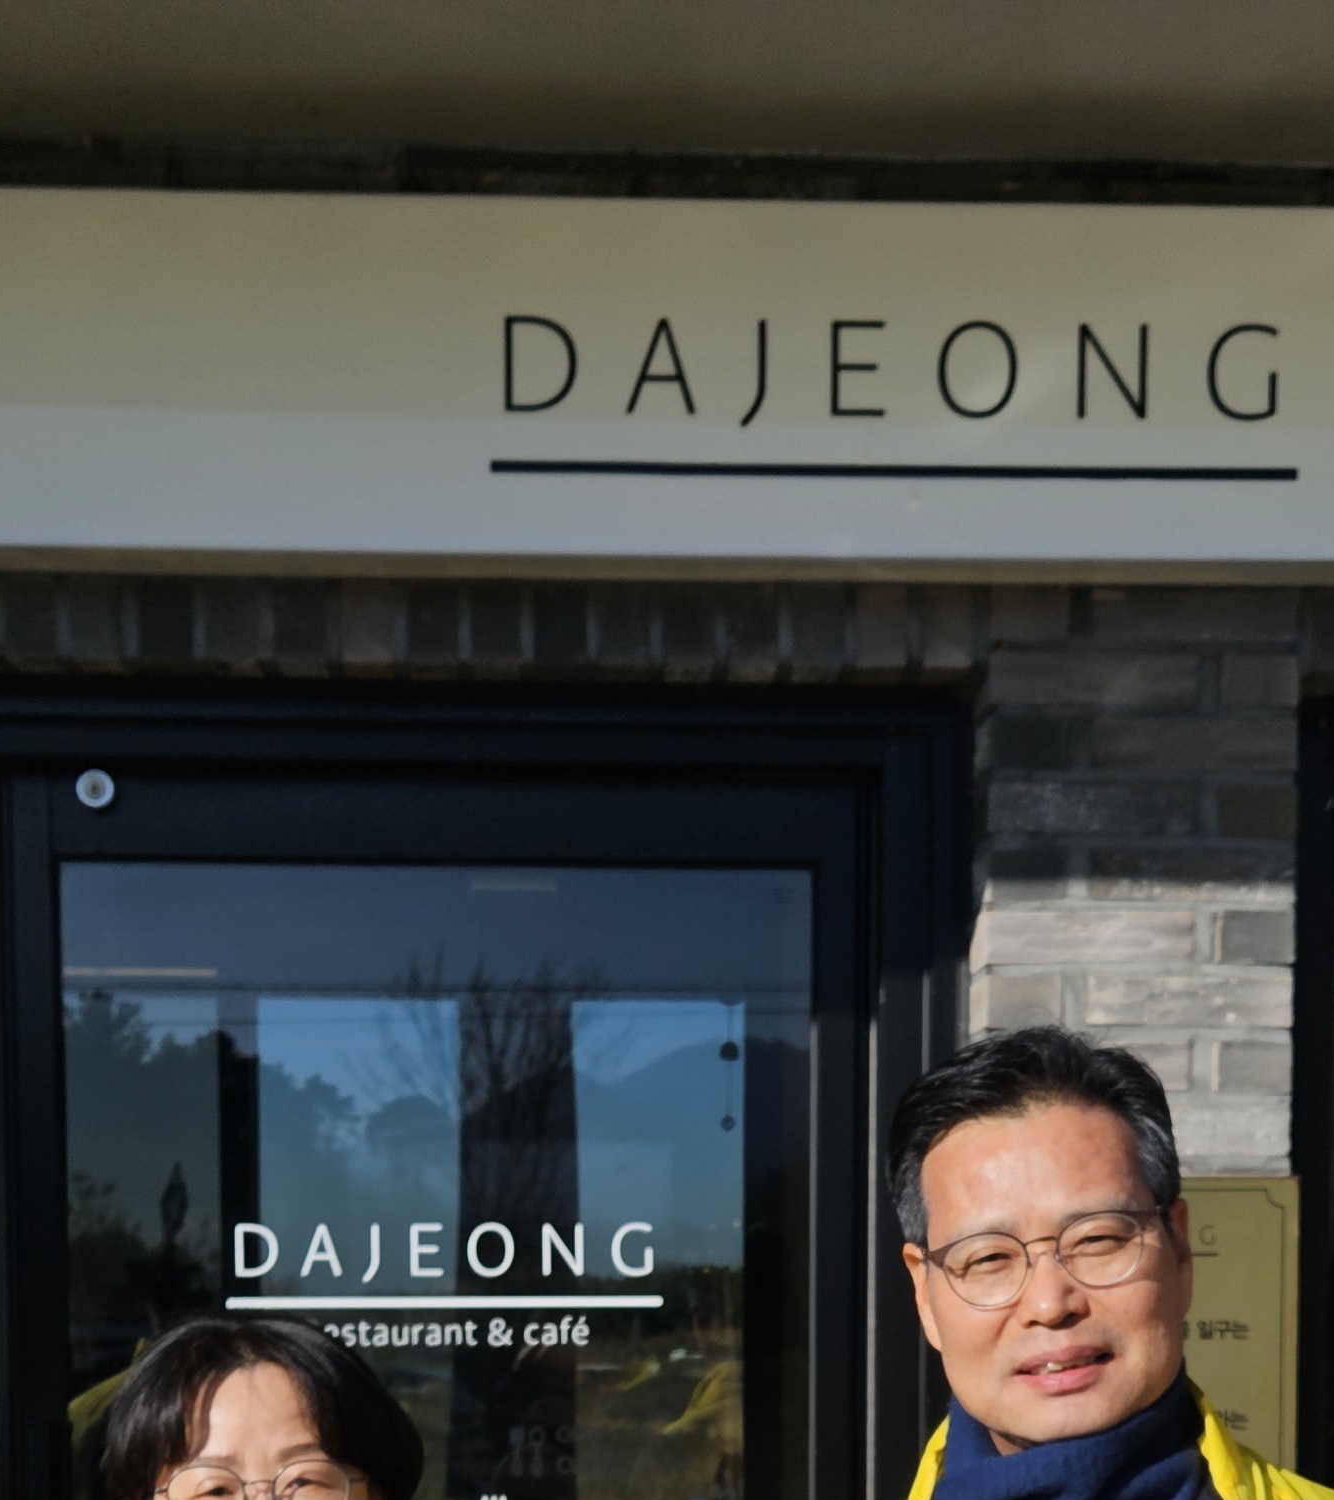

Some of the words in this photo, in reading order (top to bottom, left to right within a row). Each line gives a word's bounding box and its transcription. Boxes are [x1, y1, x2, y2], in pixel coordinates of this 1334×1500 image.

[503, 314, 1280, 427] DAJEONG
[234, 1222, 655, 1283] DAJEONG
[323, 1319, 478, 1348] staurant
[487, 1316, 514, 1348] &
[523, 1314, 592, 1347] café
